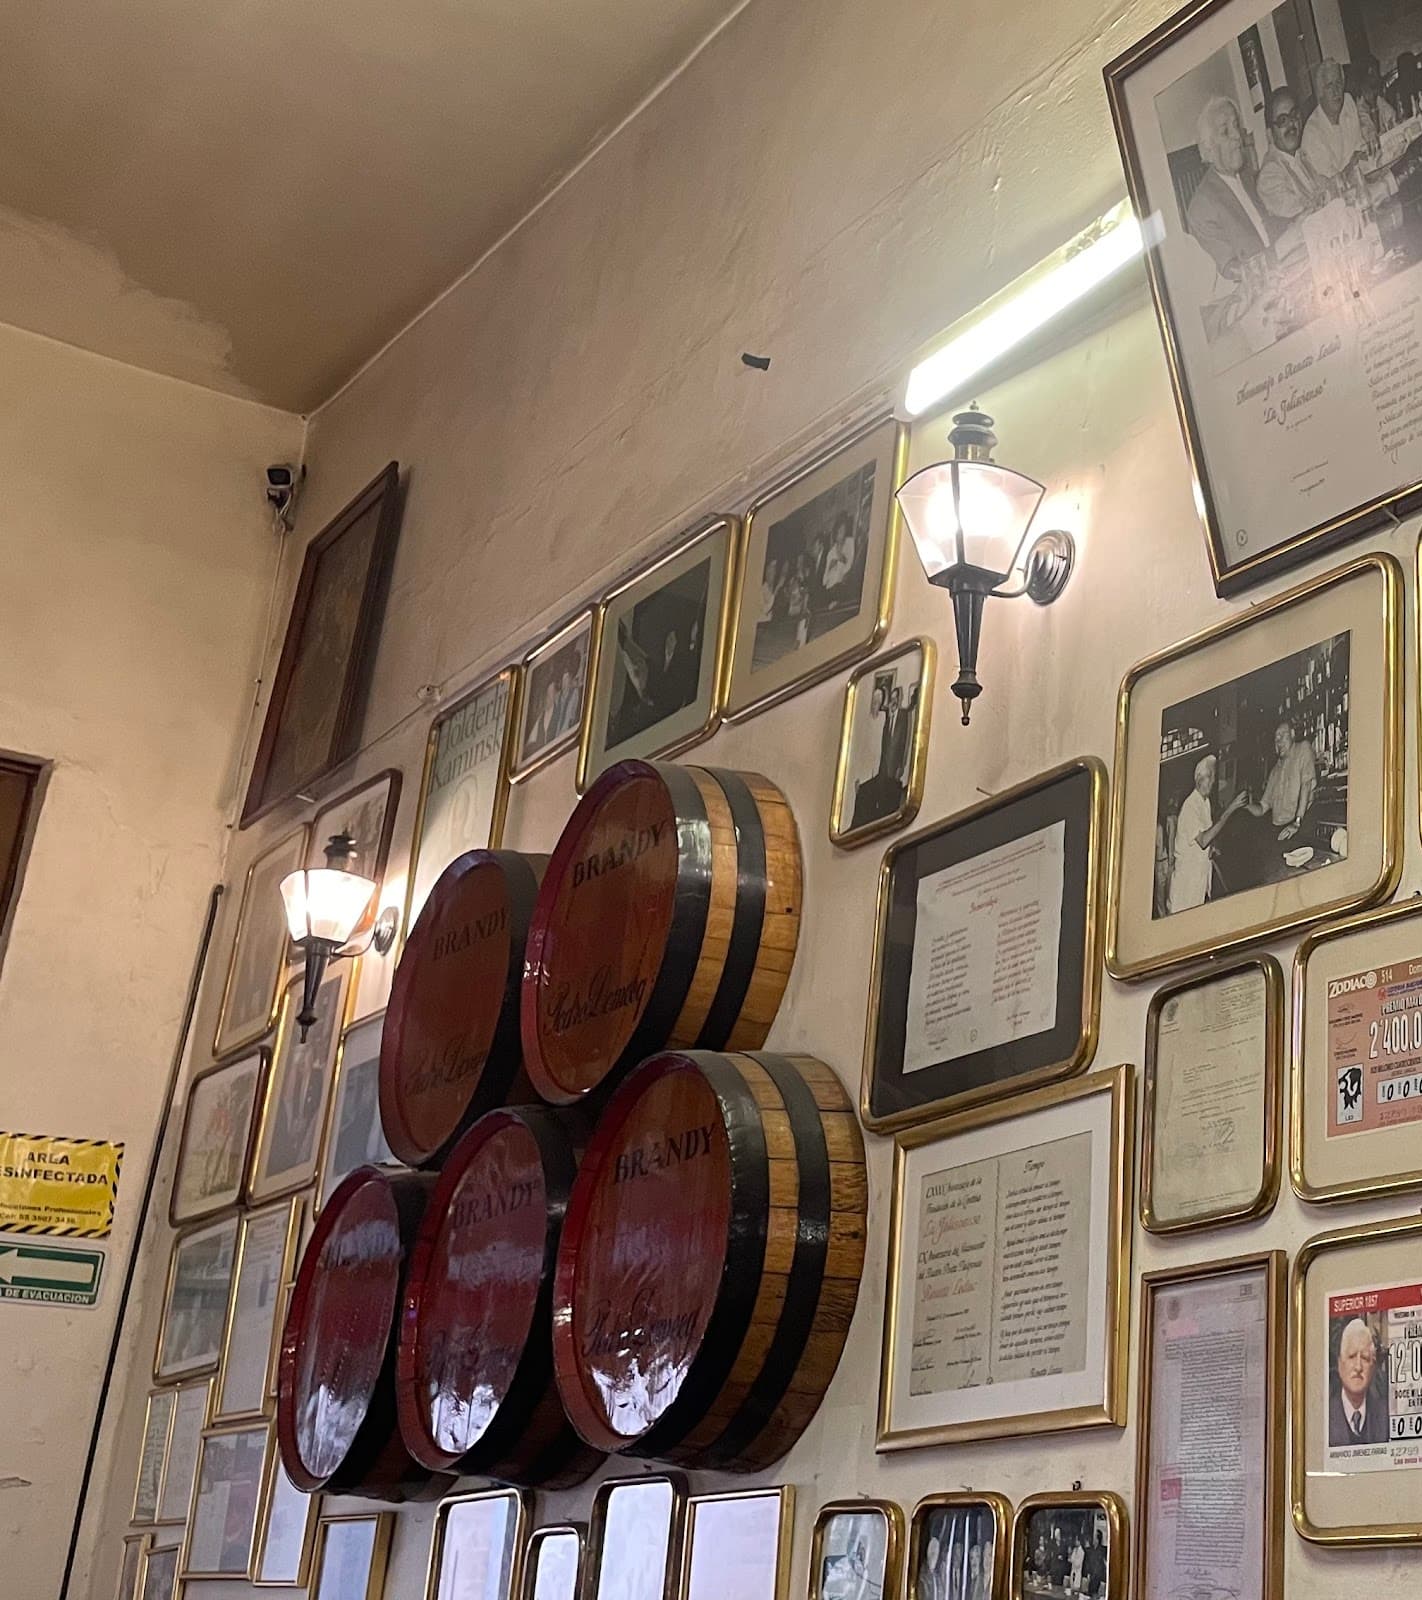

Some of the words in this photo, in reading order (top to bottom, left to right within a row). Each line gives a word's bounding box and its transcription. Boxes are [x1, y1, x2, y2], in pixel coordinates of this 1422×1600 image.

[572, 820, 668, 889] BRANDY
[433, 910, 507, 961] BRANDY
[1328, 971, 1377, 998] ZODIACO
[1381, 969, 1392, 983] 514
[1387, 1084, 1394, 1100] 0
[1403, 1080, 1410, 1097] 0
[614, 1122, 717, 1186] BRANDY
[0, 1166, 108, 1185] SINFECTADA
[451, 1182, 540, 1229] BRANDY
[5, 1289, 19, 1297] DE
[1334, 1297, 1364, 1312] SUPERIOR
[1395, 1389, 1410, 1399] DOCE
[1408, 1399, 1417, 1407] EN
[1398, 1418, 1405, 1435] 0
[1415, 1416, 1422, 1434] 0
